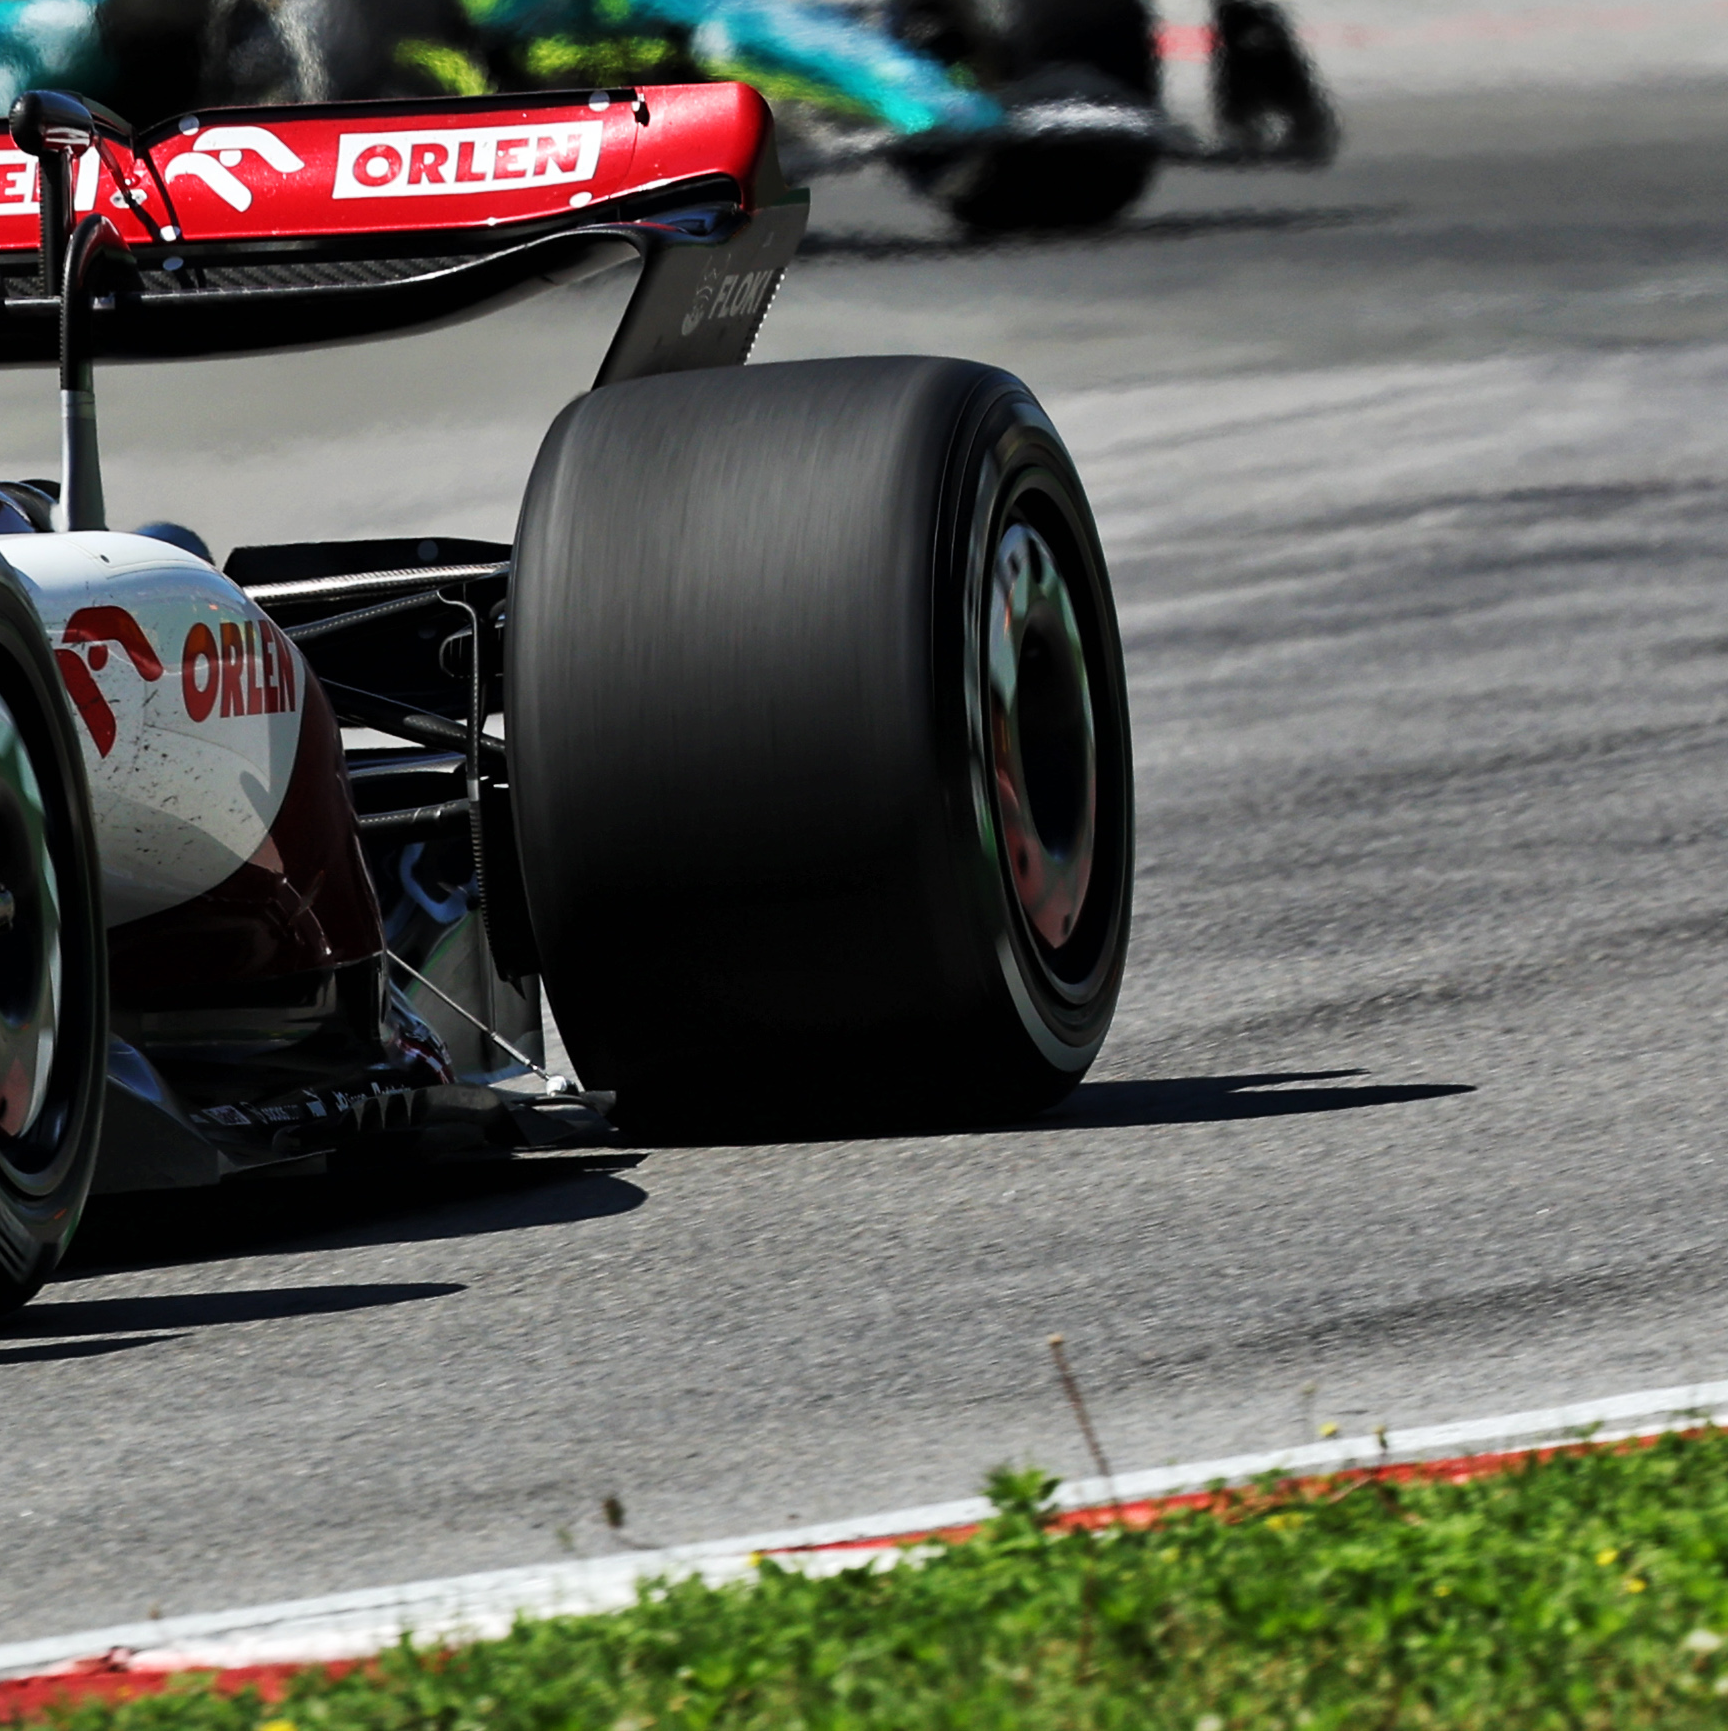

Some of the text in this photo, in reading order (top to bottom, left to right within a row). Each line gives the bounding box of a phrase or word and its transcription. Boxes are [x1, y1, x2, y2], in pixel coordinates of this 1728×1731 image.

[349, 130, 583, 188] ORLEN
[708, 270, 774, 319] FLOKI
[181, 611, 296, 722] ORLEN
